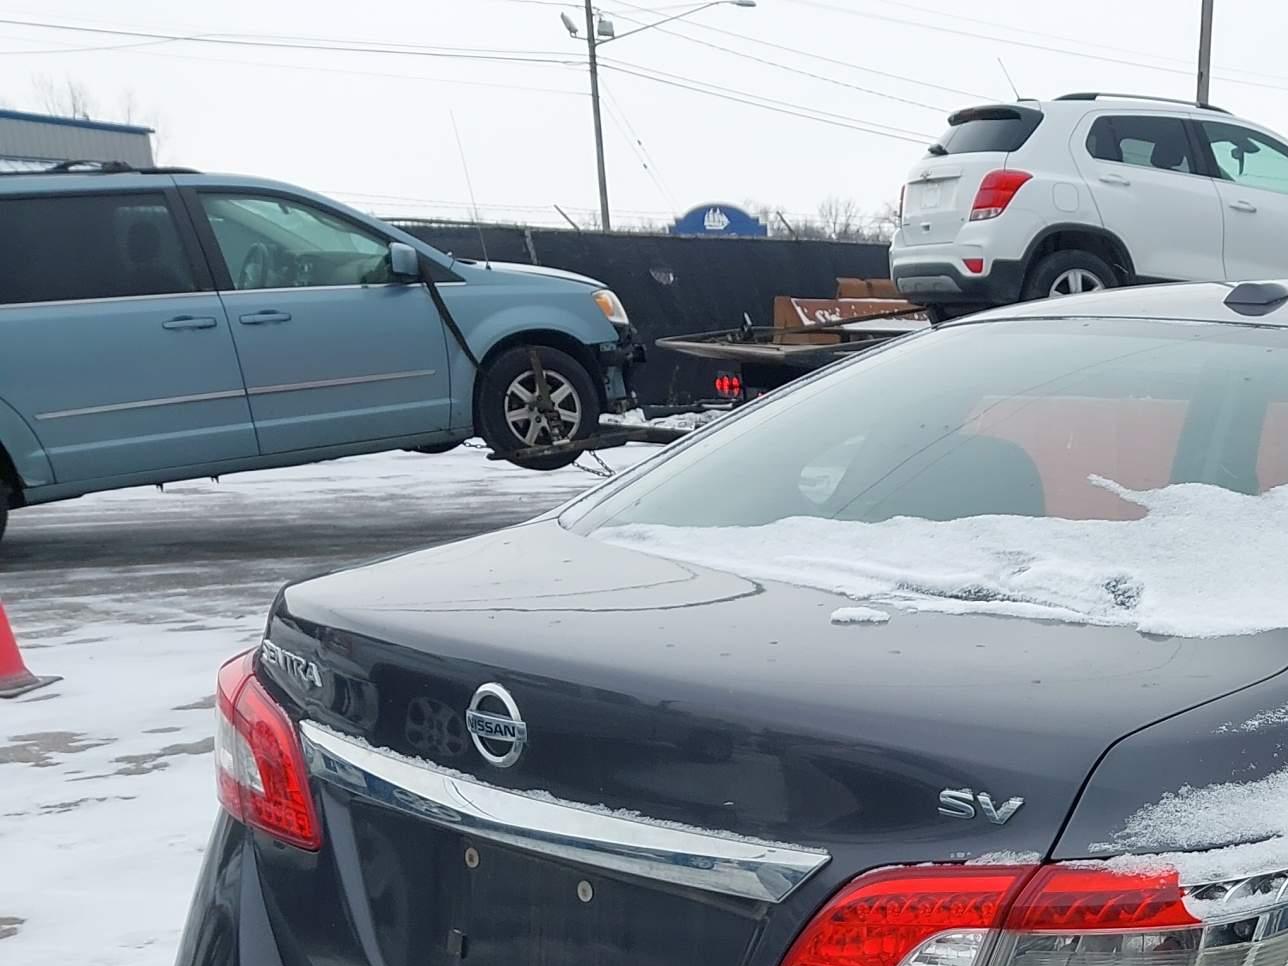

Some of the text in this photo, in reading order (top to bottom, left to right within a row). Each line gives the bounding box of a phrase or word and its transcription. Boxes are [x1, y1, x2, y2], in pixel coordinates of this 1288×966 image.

[262, 639, 322, 687] SENTRA
[468, 715, 516, 738] NISSAN
[937, 788, 1024, 825] SV
